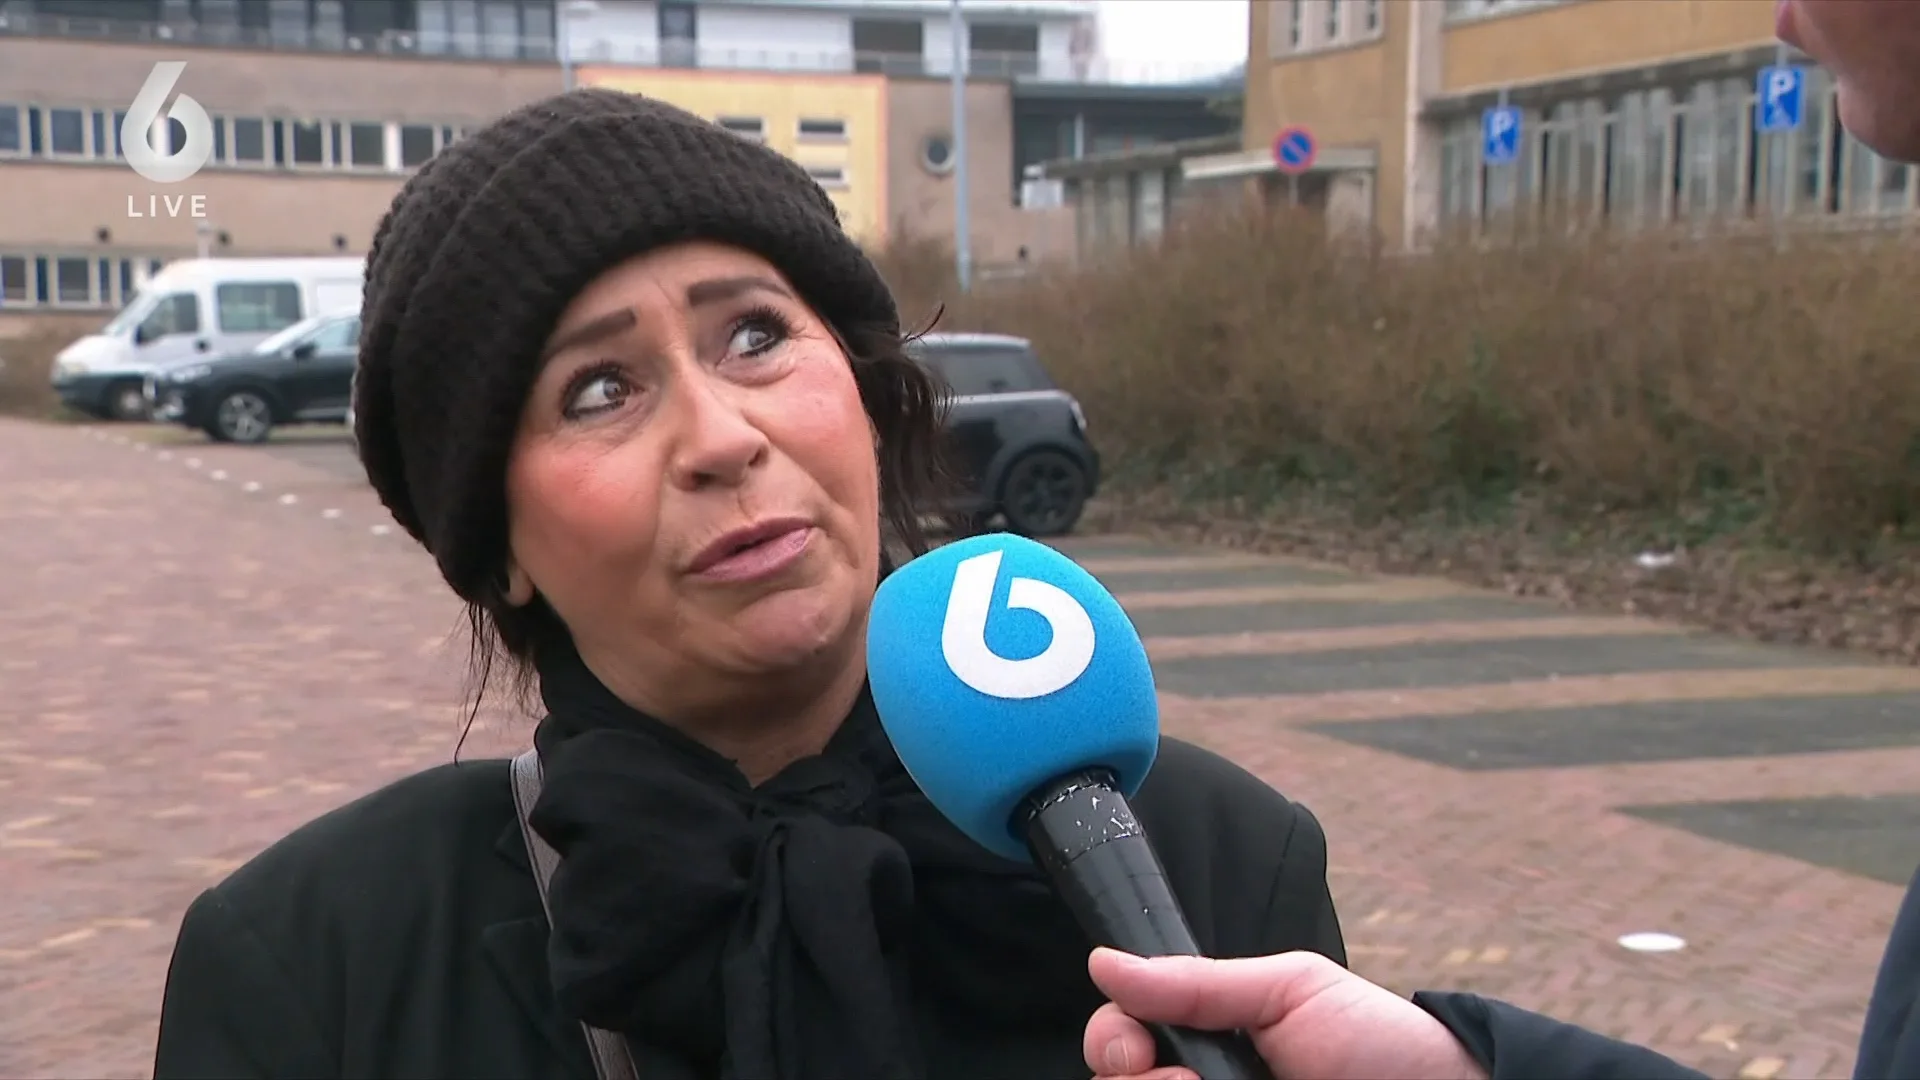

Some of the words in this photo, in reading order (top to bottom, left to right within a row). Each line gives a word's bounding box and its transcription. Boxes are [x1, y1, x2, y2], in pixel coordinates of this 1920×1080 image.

[1769, 70, 1795, 102] P
[1491, 111, 1514, 138] P
[941, 549, 1096, 699] 6
